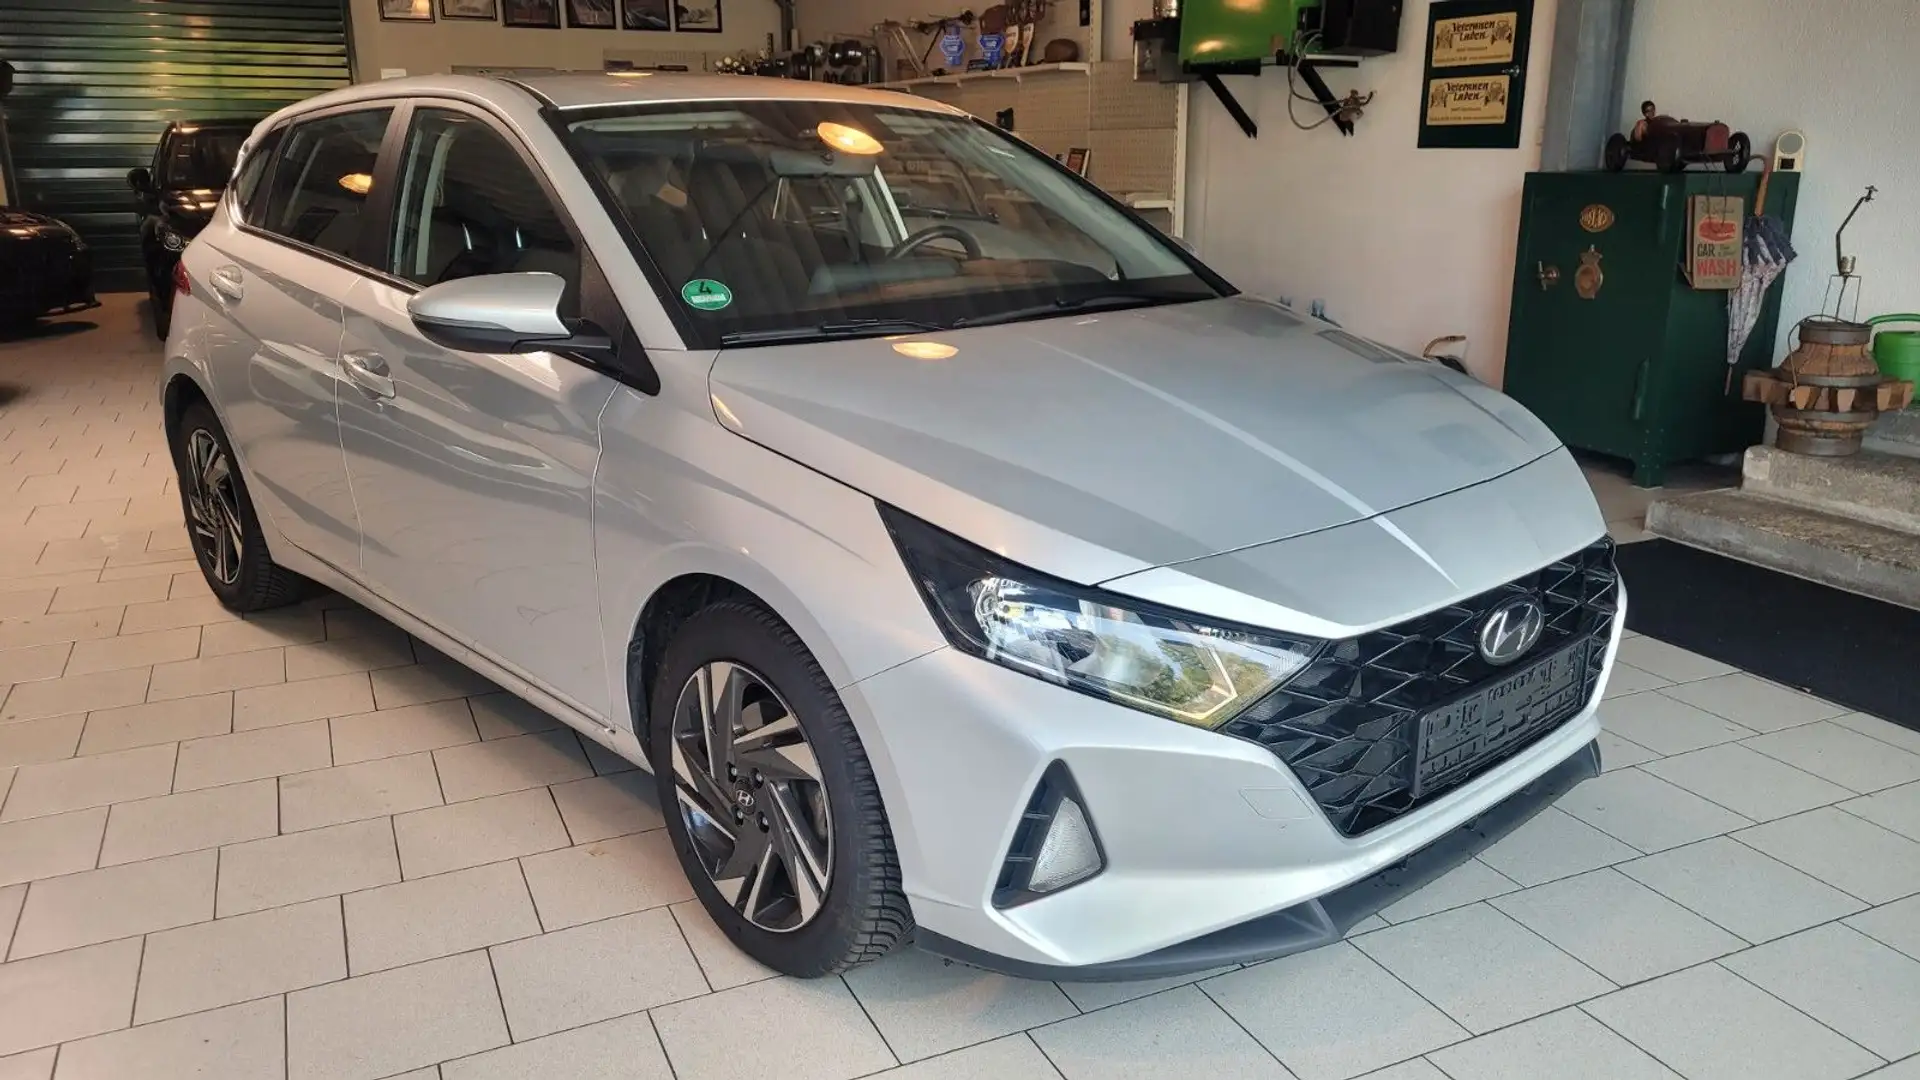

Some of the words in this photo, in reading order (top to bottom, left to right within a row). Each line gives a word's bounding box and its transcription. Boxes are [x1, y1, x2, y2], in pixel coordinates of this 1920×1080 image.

[1697, 243, 1716, 257] CAR
[1696, 259, 1737, 276] WASH
[699, 281, 712, 294] 4
